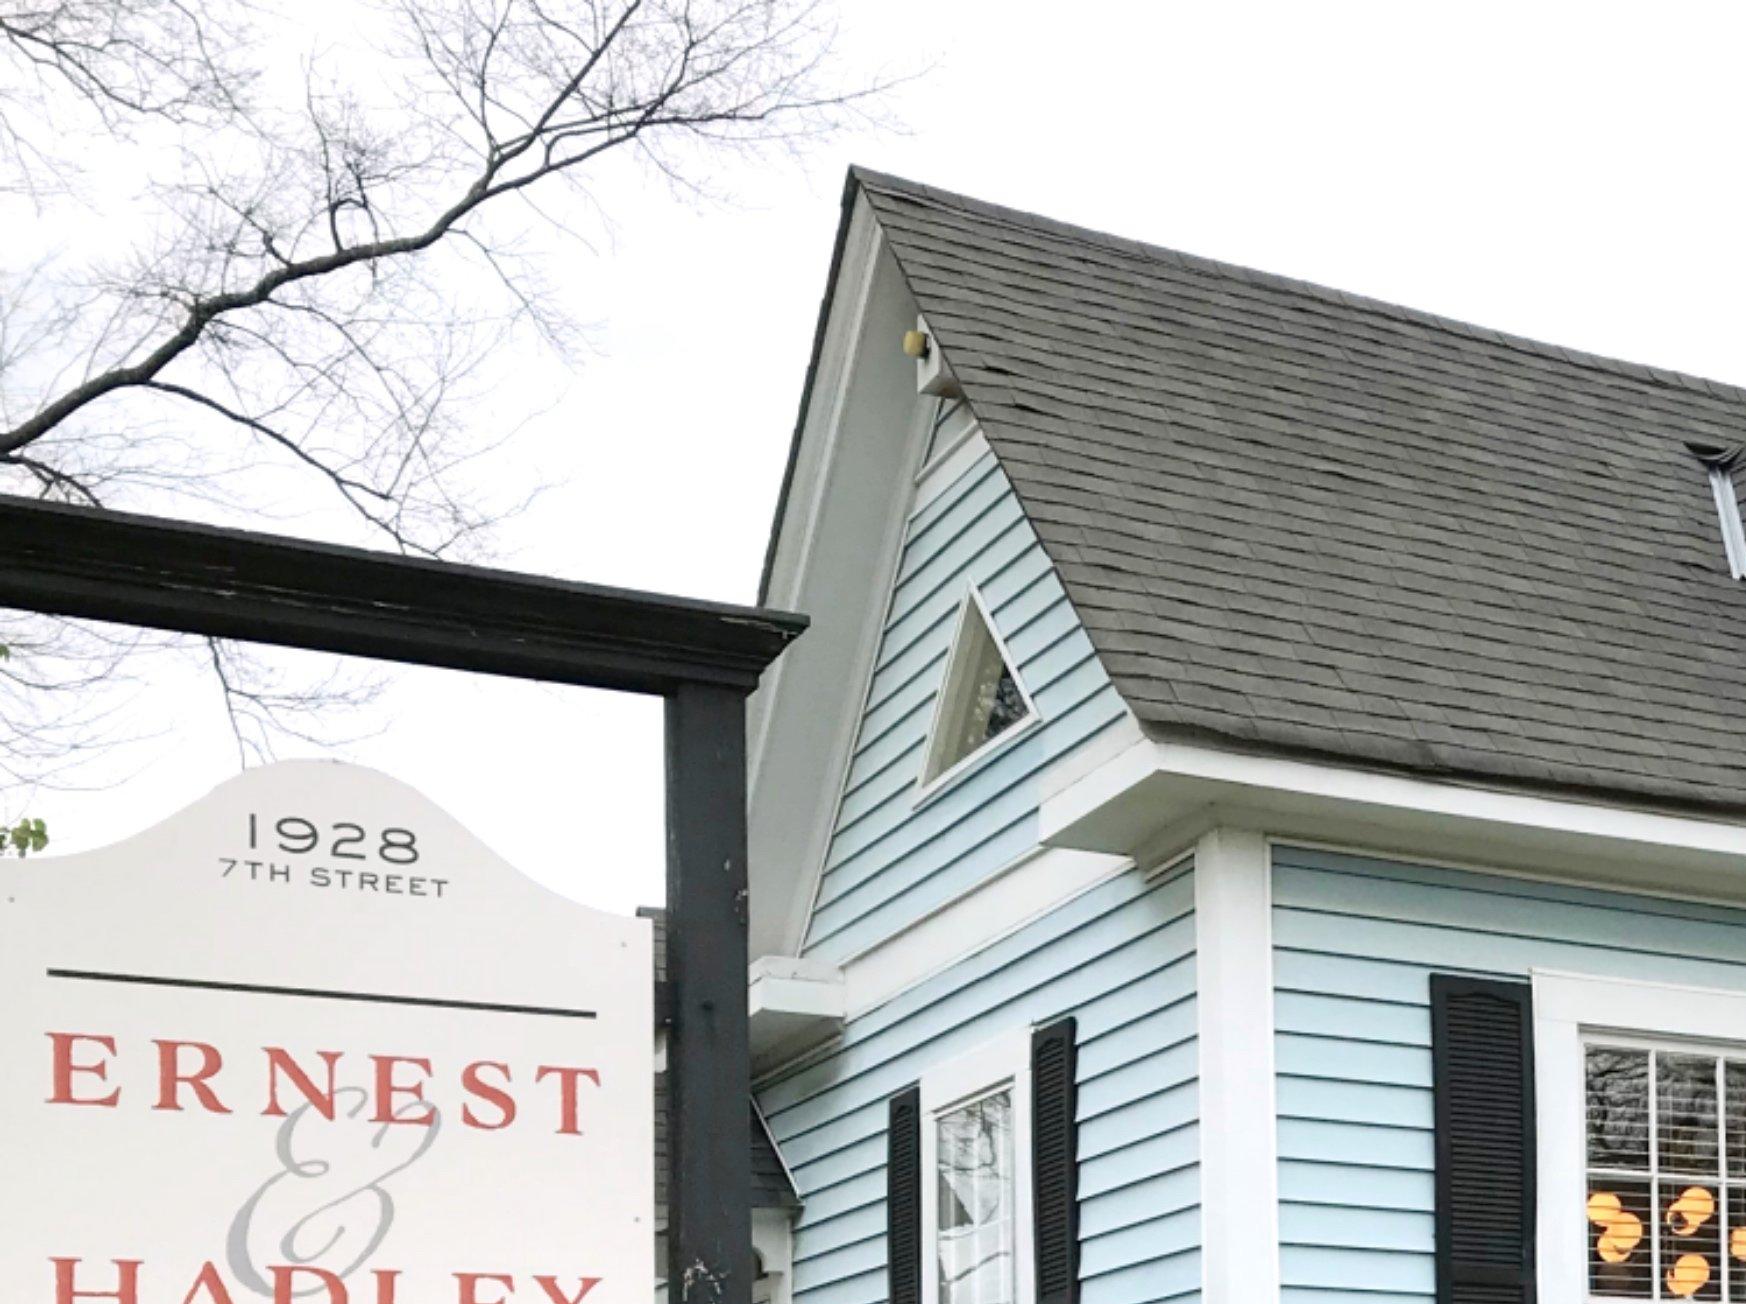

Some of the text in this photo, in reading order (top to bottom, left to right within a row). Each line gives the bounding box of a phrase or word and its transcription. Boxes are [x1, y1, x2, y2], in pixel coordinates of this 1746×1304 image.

[218, 858, 449, 898] 7TH STREET
[249, 813, 420, 865] 1928
[45, 1031, 600, 1136] ERNEST
[226, 1086, 442, 1300] &
